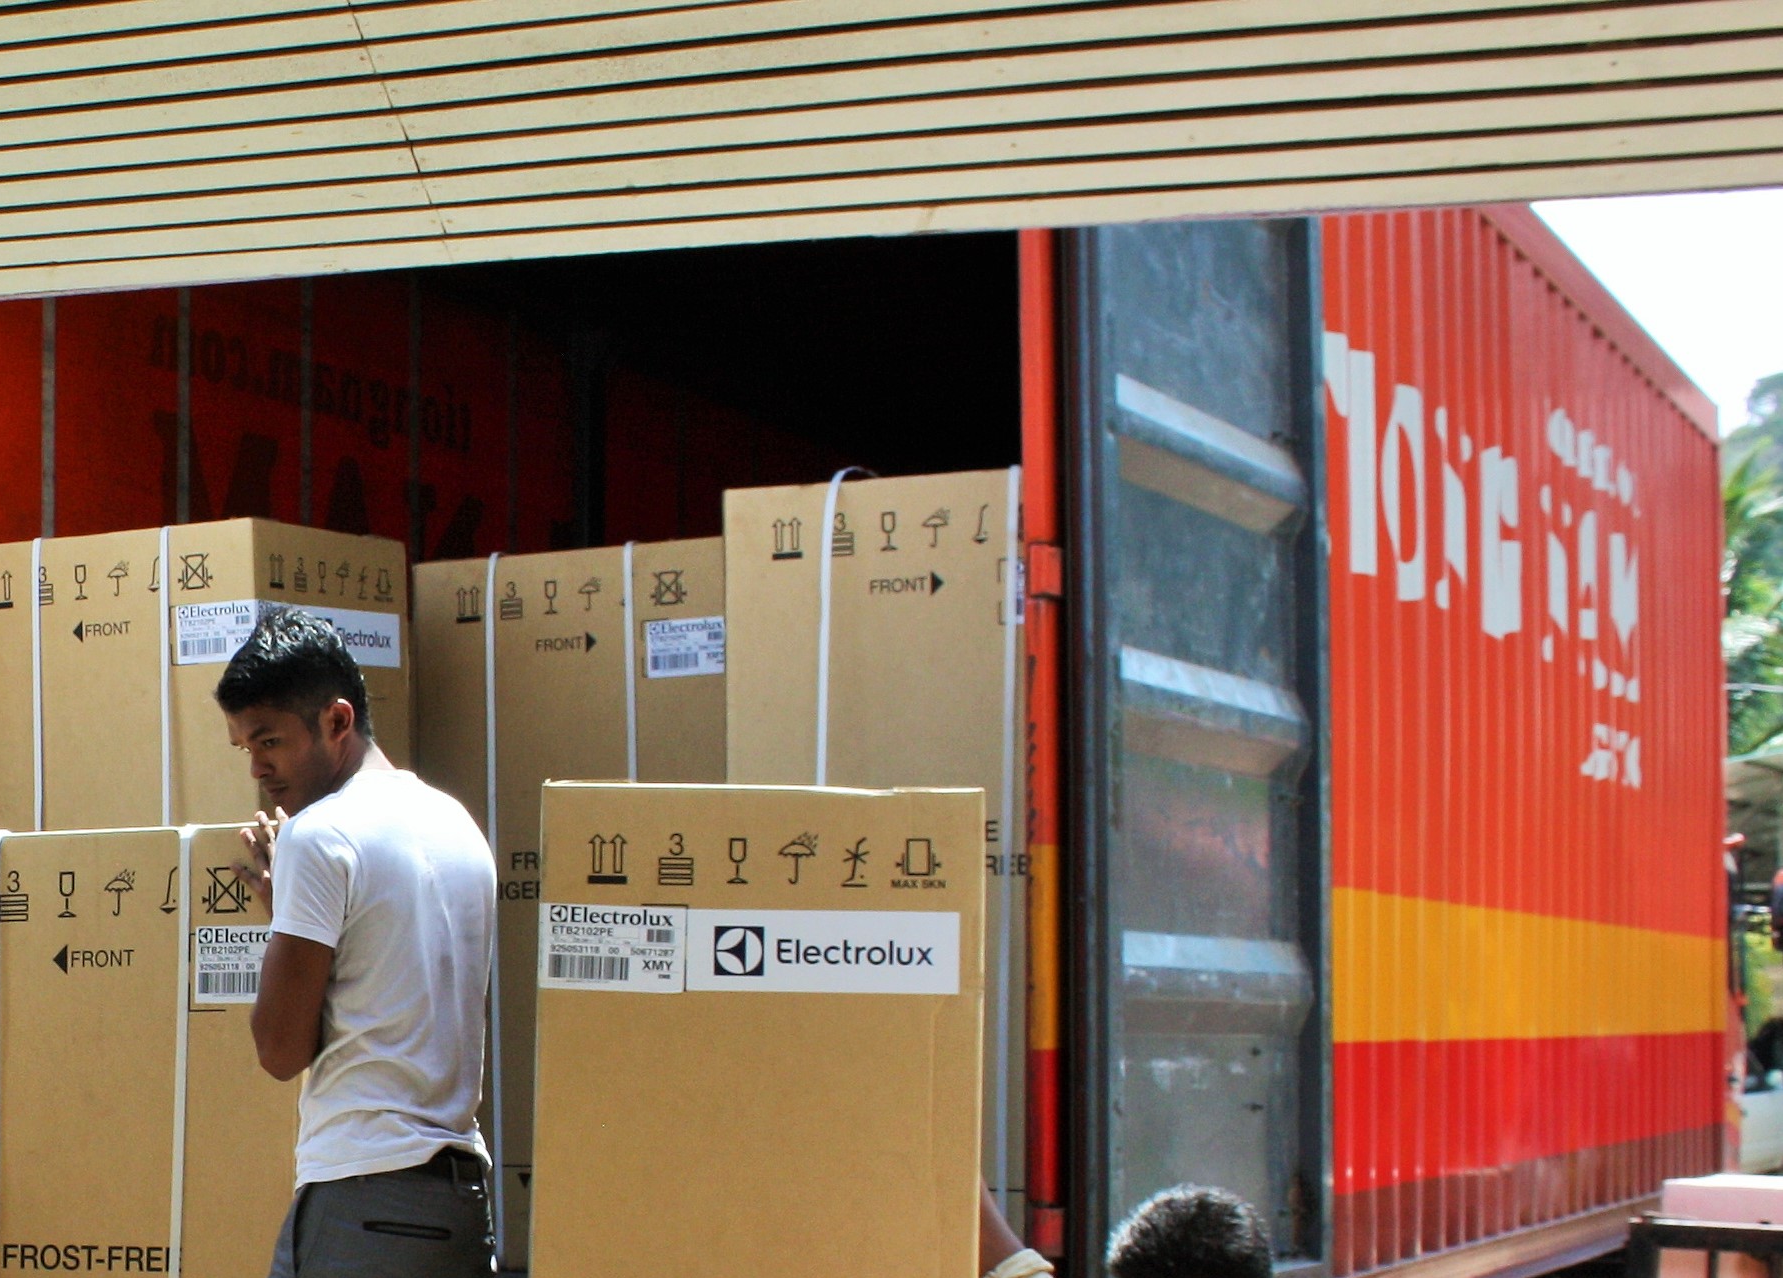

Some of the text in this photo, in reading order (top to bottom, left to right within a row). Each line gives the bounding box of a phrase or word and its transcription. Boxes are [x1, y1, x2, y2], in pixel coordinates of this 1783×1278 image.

[834, 512, 846, 532] 3
[506, 581, 516, 598] 3
[869, 576, 928, 595] FRONT
[190, 602, 250, 618] Electrolux
[85, 621, 131, 637] FRONT
[535, 636, 584, 651] FRONT
[669, 833, 685, 856] 3
[7, 870, 20, 893] 3
[571, 906, 673, 926] Electrolux
[215, 928, 271, 943] Electro
[552, 925, 614, 937] ETB2102PE
[71, 950, 135, 968] FRONT
[200, 946, 249, 955] ETB2102PE
[776, 938, 934, 966] Electrolux
[642, 960, 673, 971] XMY
